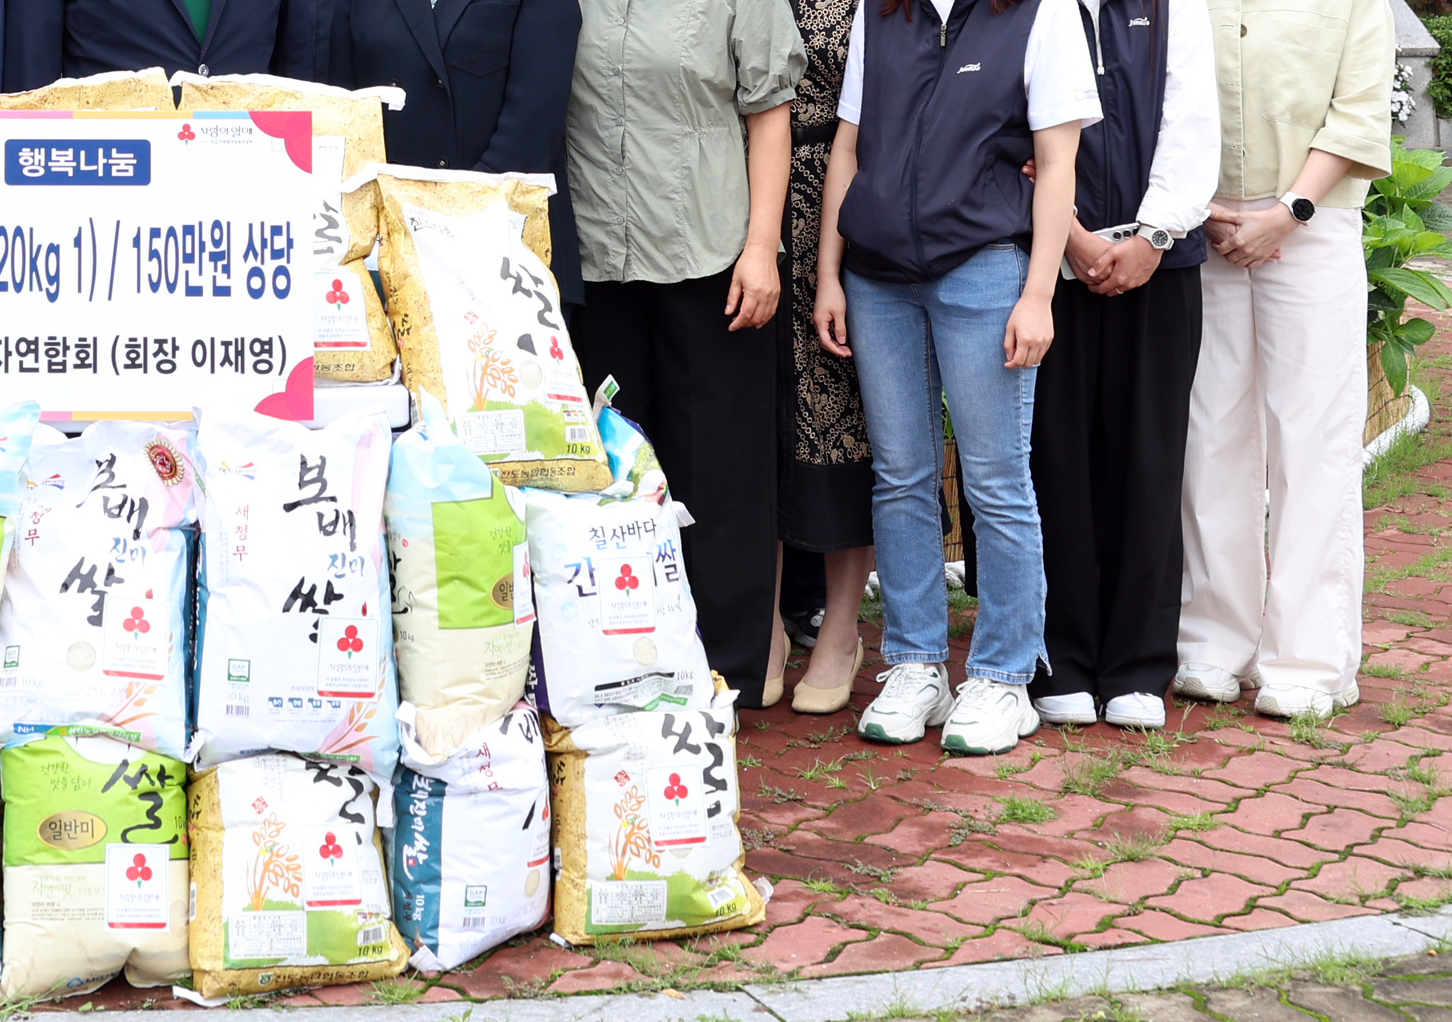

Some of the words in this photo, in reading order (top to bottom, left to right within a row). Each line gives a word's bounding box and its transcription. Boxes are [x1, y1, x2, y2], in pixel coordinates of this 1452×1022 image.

[18, 147, 137, 177] 행복나눔
[73, 217, 97, 302] 1)
[108, 219, 121, 301] /
[132, 219, 231, 297] 150만원
[243, 221, 294, 299] 상당
[111, 335, 180, 376] (회장
[191, 335, 287, 376] 이재영)
[283, 453, 357, 552] 보배
[109, 536, 146, 566] 진미
[589, 518, 657, 552] 칠산바다
[327, 552, 366, 578] 진미
[564, 538, 679, 598] 간쌀
[59, 555, 125, 628] 쌀
[282, 576, 344, 644] 쌀
[661, 711, 728, 818] 쌀
[101, 759, 179, 844] 쌀
[49, 818, 95, 841] 일반미
[415, 894, 425, 905] 10
